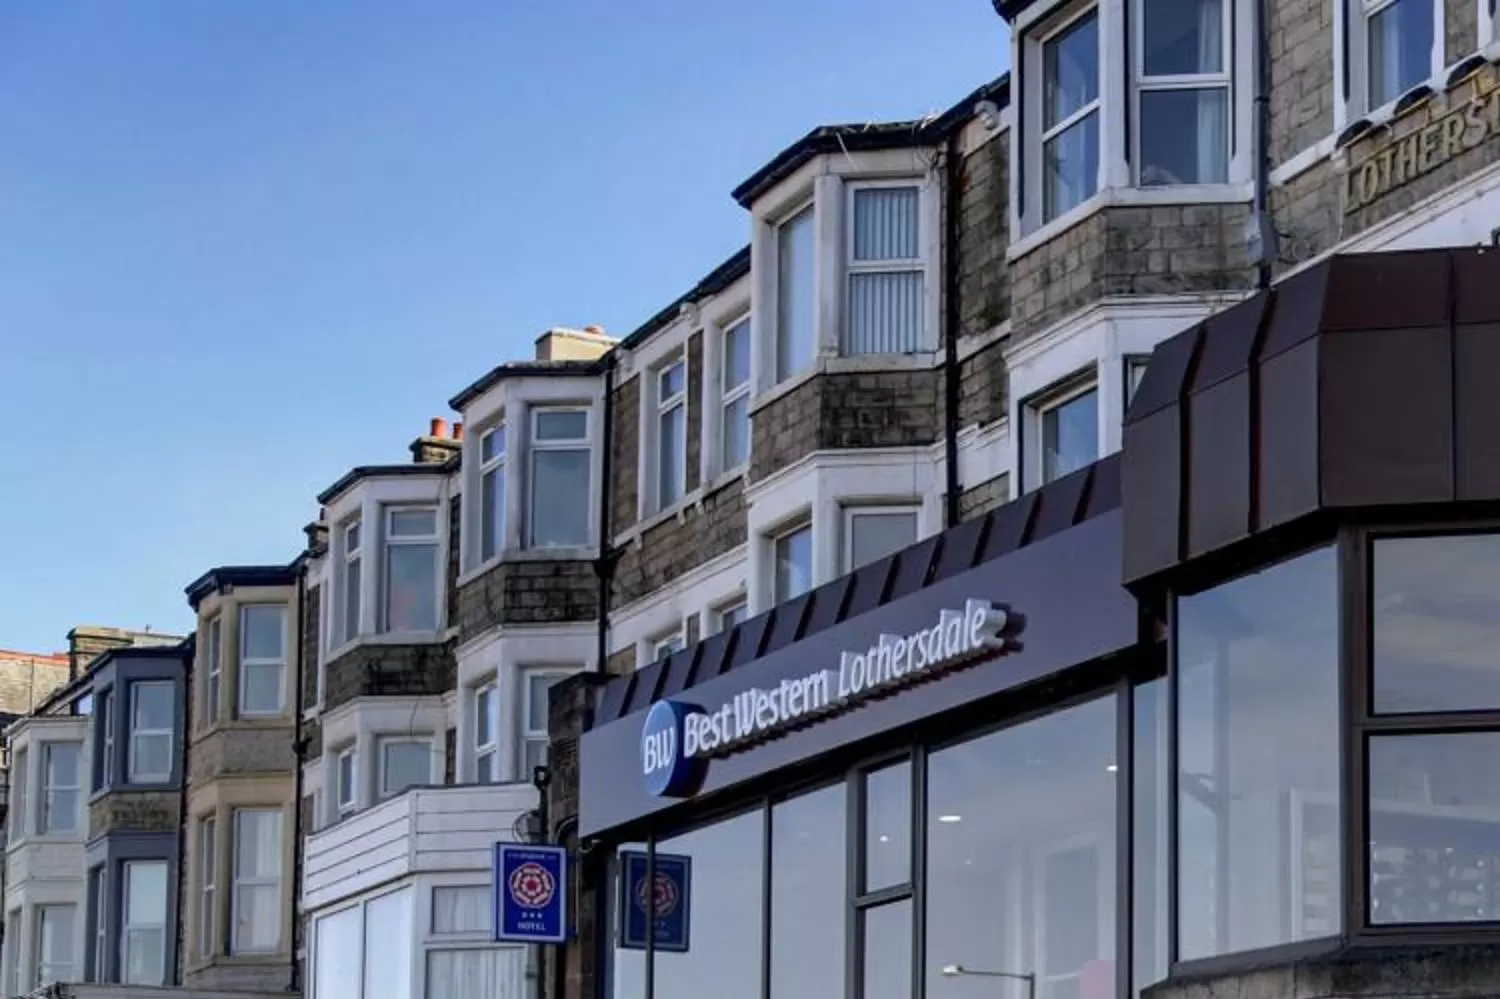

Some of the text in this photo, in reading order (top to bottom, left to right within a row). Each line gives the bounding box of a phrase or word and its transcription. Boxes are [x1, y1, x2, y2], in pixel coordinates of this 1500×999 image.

[684, 597, 987, 758] Best Western Lothersdale
[643, 726, 675, 775] BW
[517, 921, 547, 931] HOTEL
